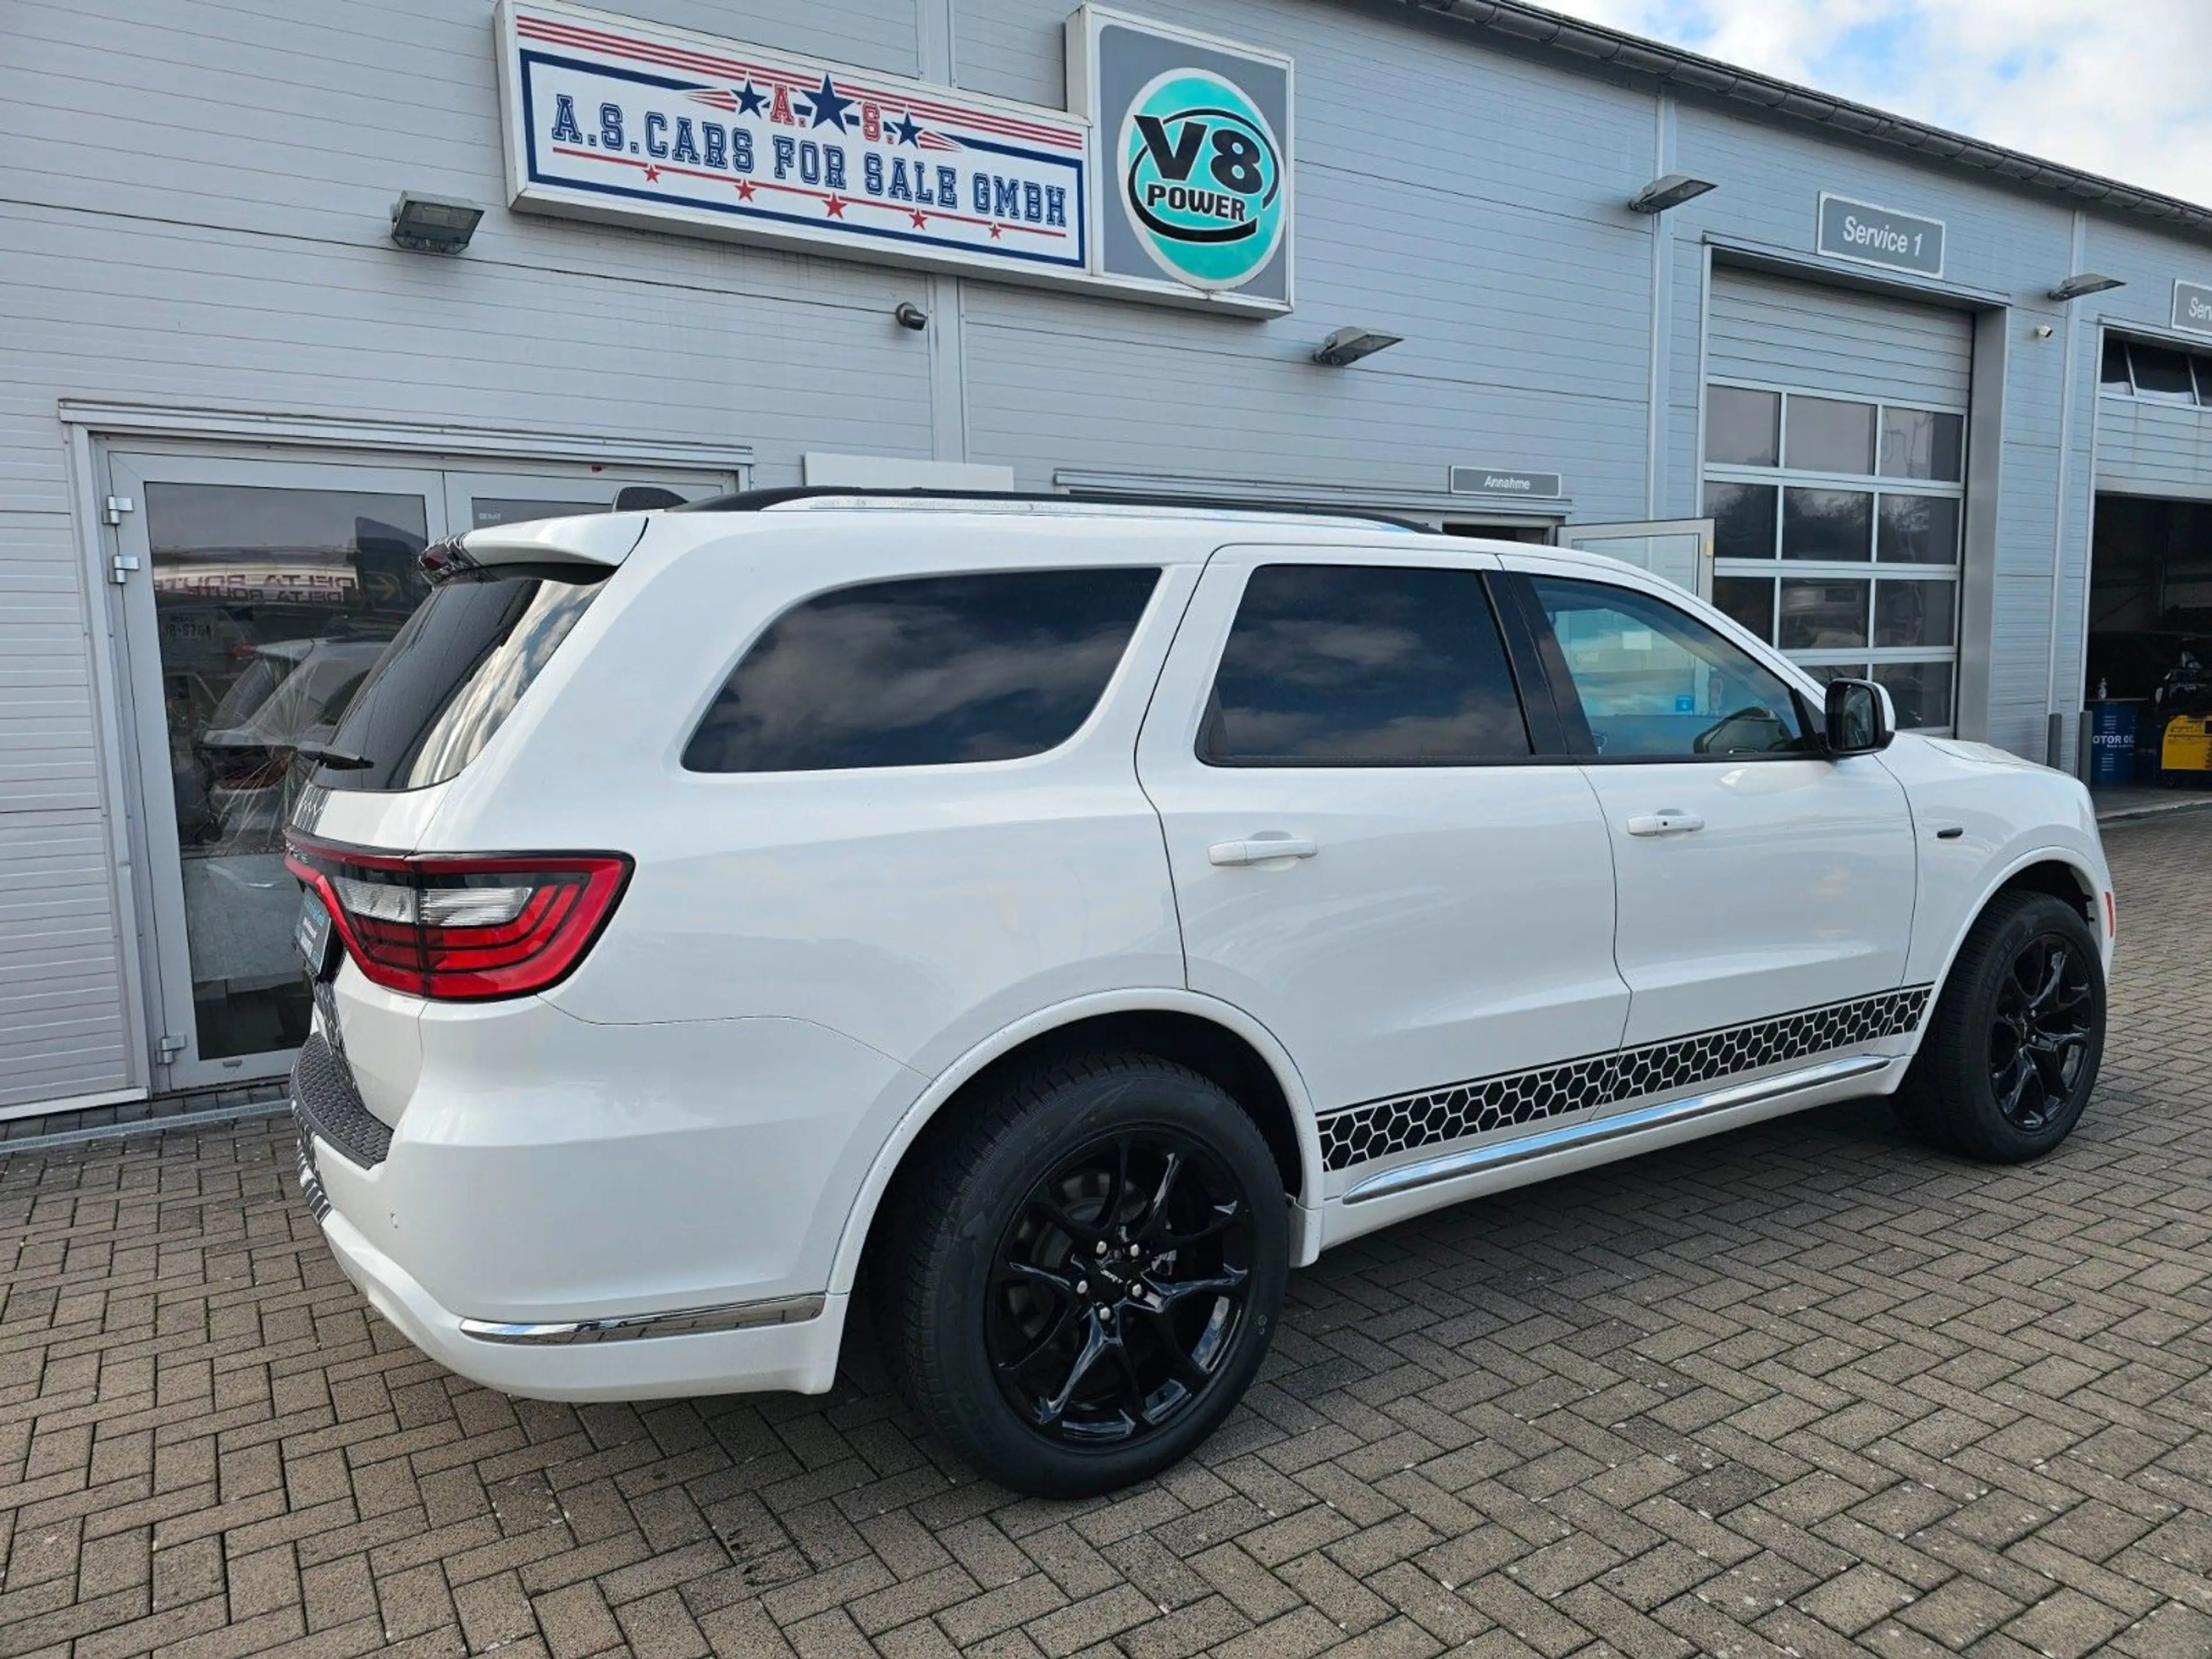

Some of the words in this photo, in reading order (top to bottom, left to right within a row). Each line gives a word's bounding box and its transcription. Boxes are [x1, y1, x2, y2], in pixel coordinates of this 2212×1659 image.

[1132, 114, 1264, 194] V8
[772, 134, 847, 191] FOR
[863, 151, 958, 210] SALE
[972, 173, 1067, 228] GMBH
[1146, 183, 1245, 222] POWER
[1843, 215, 1908, 253] Service
[1914, 232, 1923, 257] 1
[1483, 475, 1531, 490] Annahme
[2092, 735, 2122, 744] OTOR
